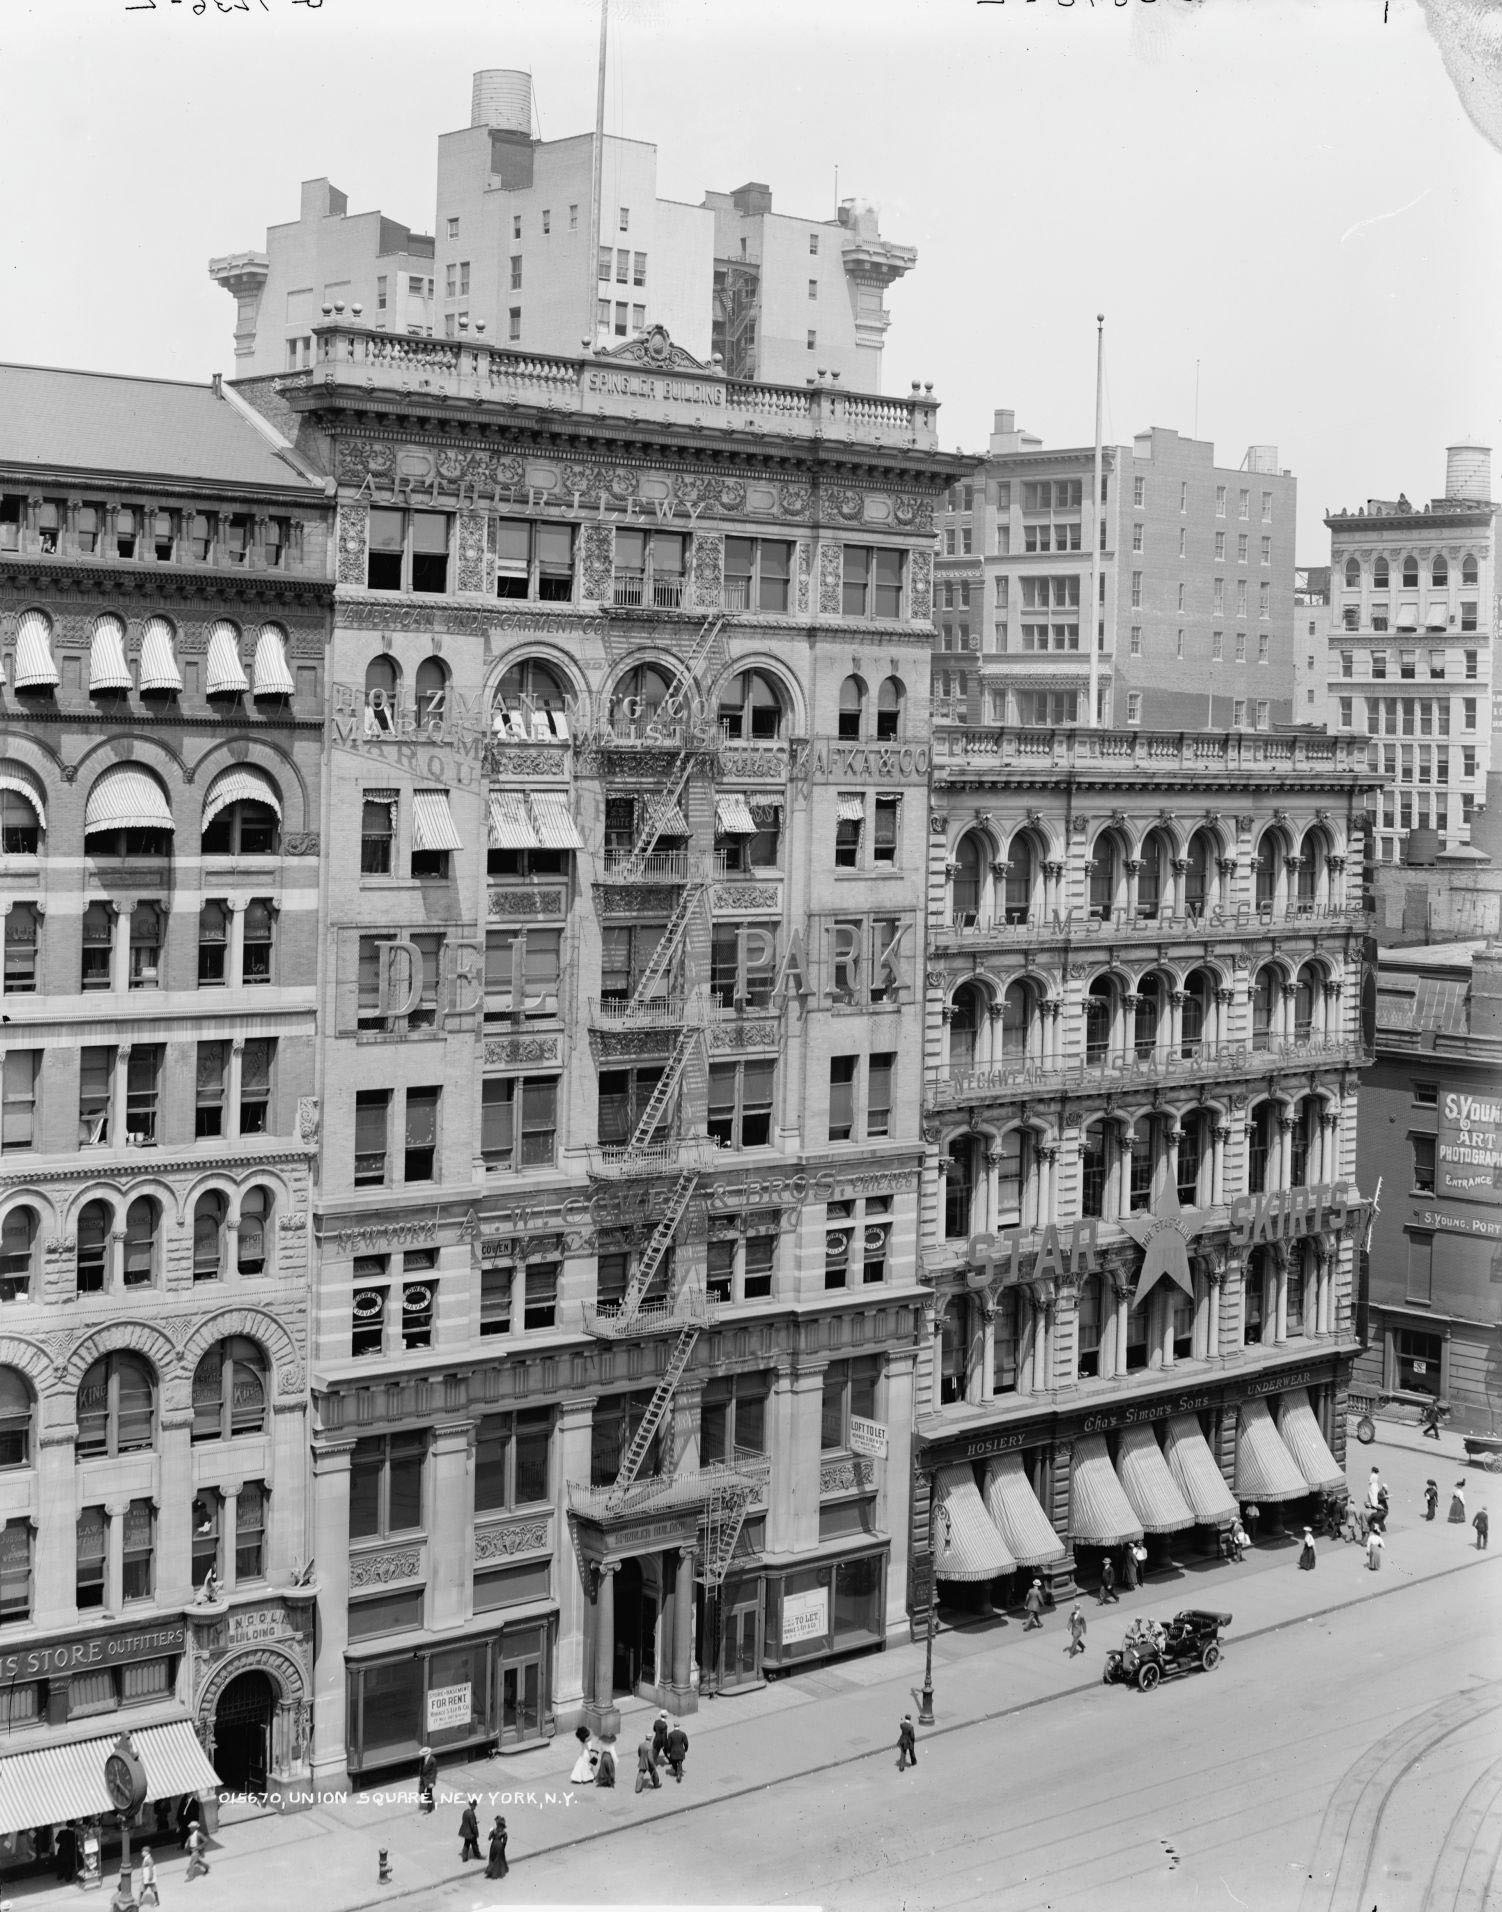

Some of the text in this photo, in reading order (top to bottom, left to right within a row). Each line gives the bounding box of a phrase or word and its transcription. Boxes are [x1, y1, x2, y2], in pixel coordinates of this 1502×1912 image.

[589, 372, 722, 406] SPINGLER BUILDING
[354, 472, 548, 515] ARTHUR
[597, 492, 706, 528] LEWY
[343, 605, 436, 628] AMERICAN
[447, 609, 574, 635] UNDERGARMENT
[335, 687, 539, 716] HOLZMAN
[572, 724, 712, 748] WAISTS
[795, 746, 873, 775] KAFKA
[878, 748, 896, 774] &
[953, 912, 1036, 938] WAISTS
[1086, 903, 1202, 936] STERN
[1209, 902, 1226, 928] &
[373, 921, 914, 1017] DEL PARK
[953, 1065, 1043, 1096] NECKWEAR
[1457, 1130, 1497, 1149] ART
[852, 1171, 914, 1193] CHICAGO
[1445, 1174, 1493, 1190] ENTRANCE
[966, 1180, 1349, 1289] STAR SKIRTS
[1247, 1372, 1311, 1396] UNDERWEAR
[1125, 1403, 1172, 1425] Simon's
[1178, 1395, 1209, 1415] Sons
[851, 1420, 865, 1433] LOFT
[874, 1427, 886, 1440] LET
[967, 1434, 1026, 1456] HOSIERY
[78, 1524, 99, 1536] LAW
[214, 1610, 291, 1637] LINCOLN
[794, 1616, 804, 1626] TO
[805, 1611, 819, 1622] LET
[227, 1626, 277, 1645] BUILDING
[26, 1642, 103, 1674] STORE
[108, 1629, 184, 1657] OUTFITTERS
[431, 1693, 468, 1710] FOR RENT
